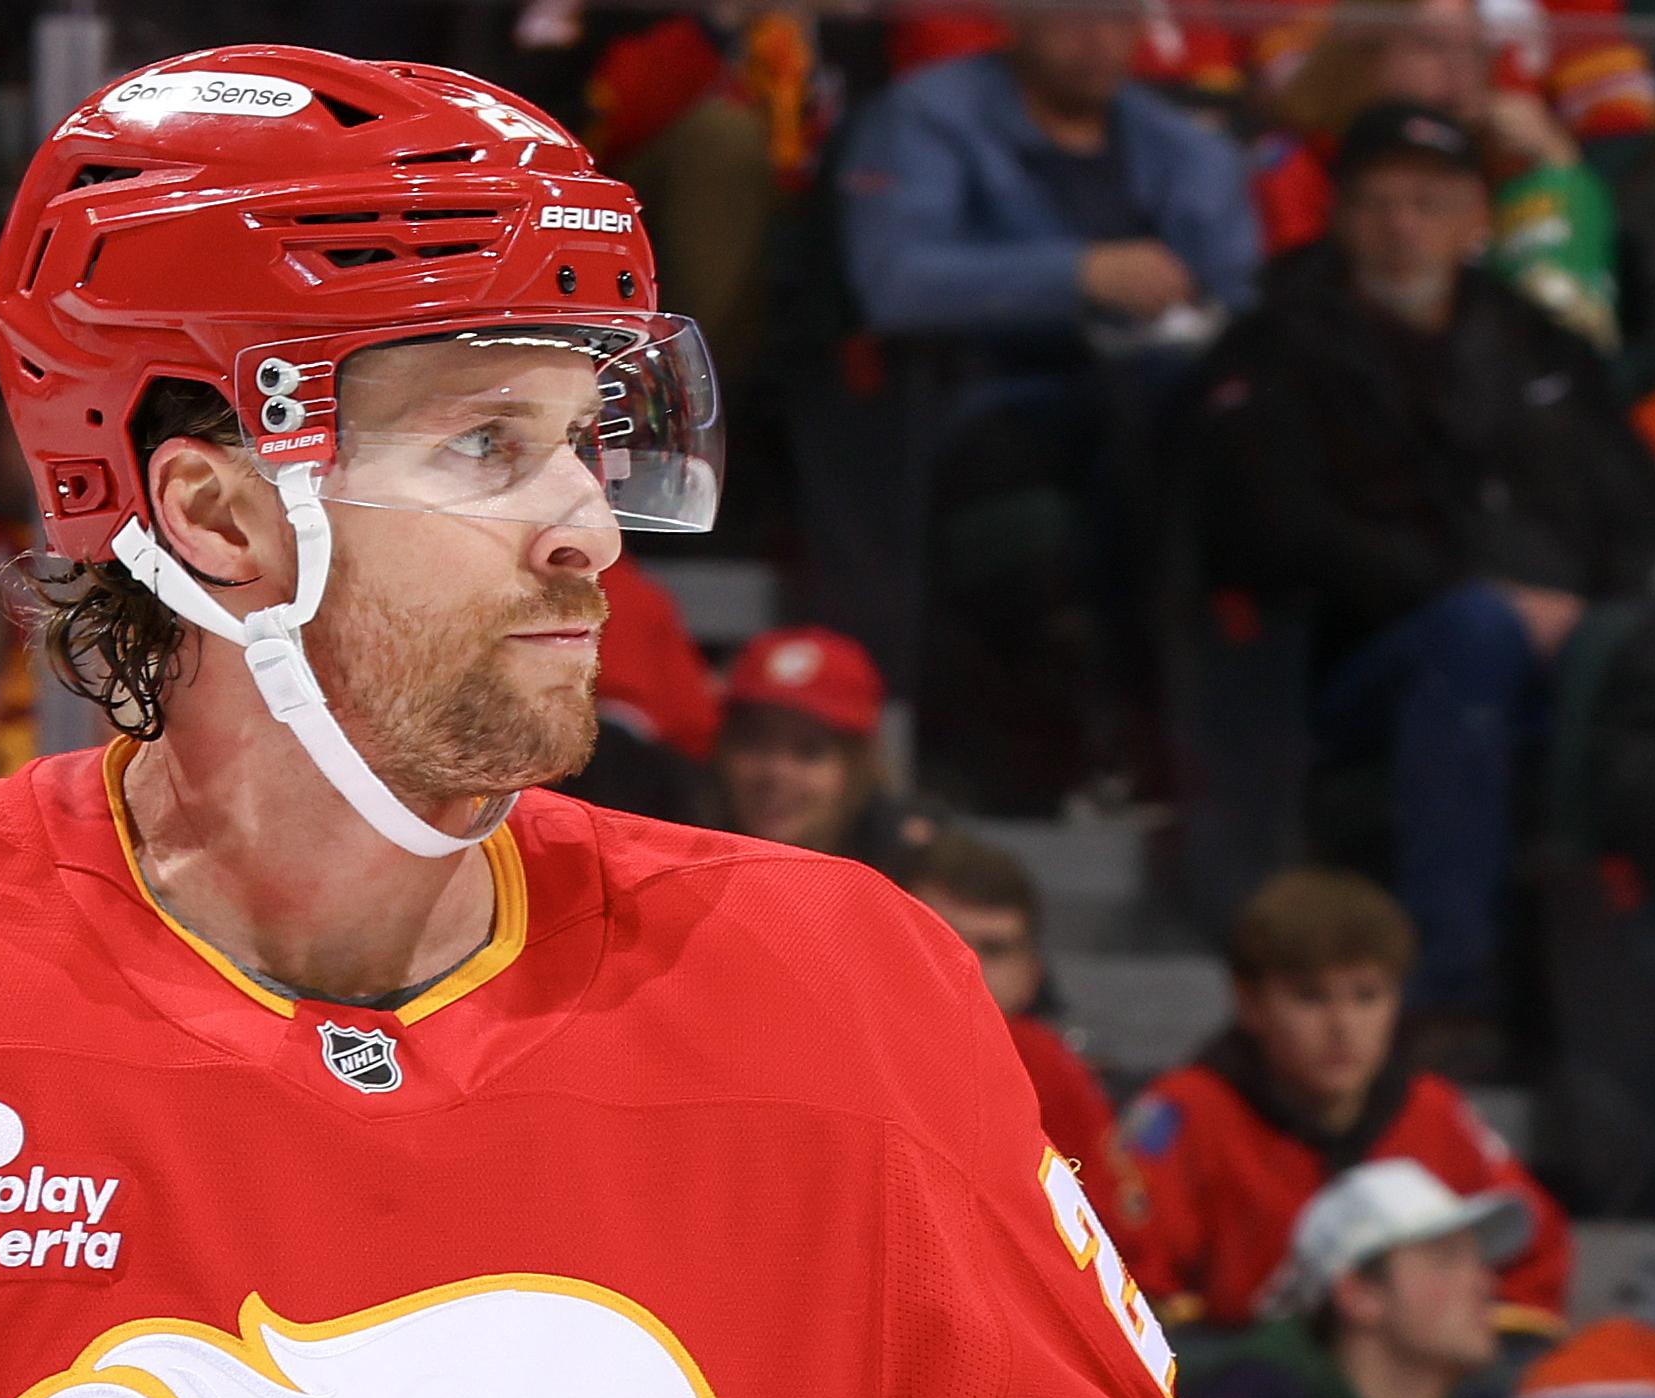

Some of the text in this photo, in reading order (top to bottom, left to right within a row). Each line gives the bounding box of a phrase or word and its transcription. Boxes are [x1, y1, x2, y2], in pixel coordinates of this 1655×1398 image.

[540, 204, 632, 233] BAUER
[260, 433, 326, 454] BAUER
[339, 1047, 382, 1073] NHL
